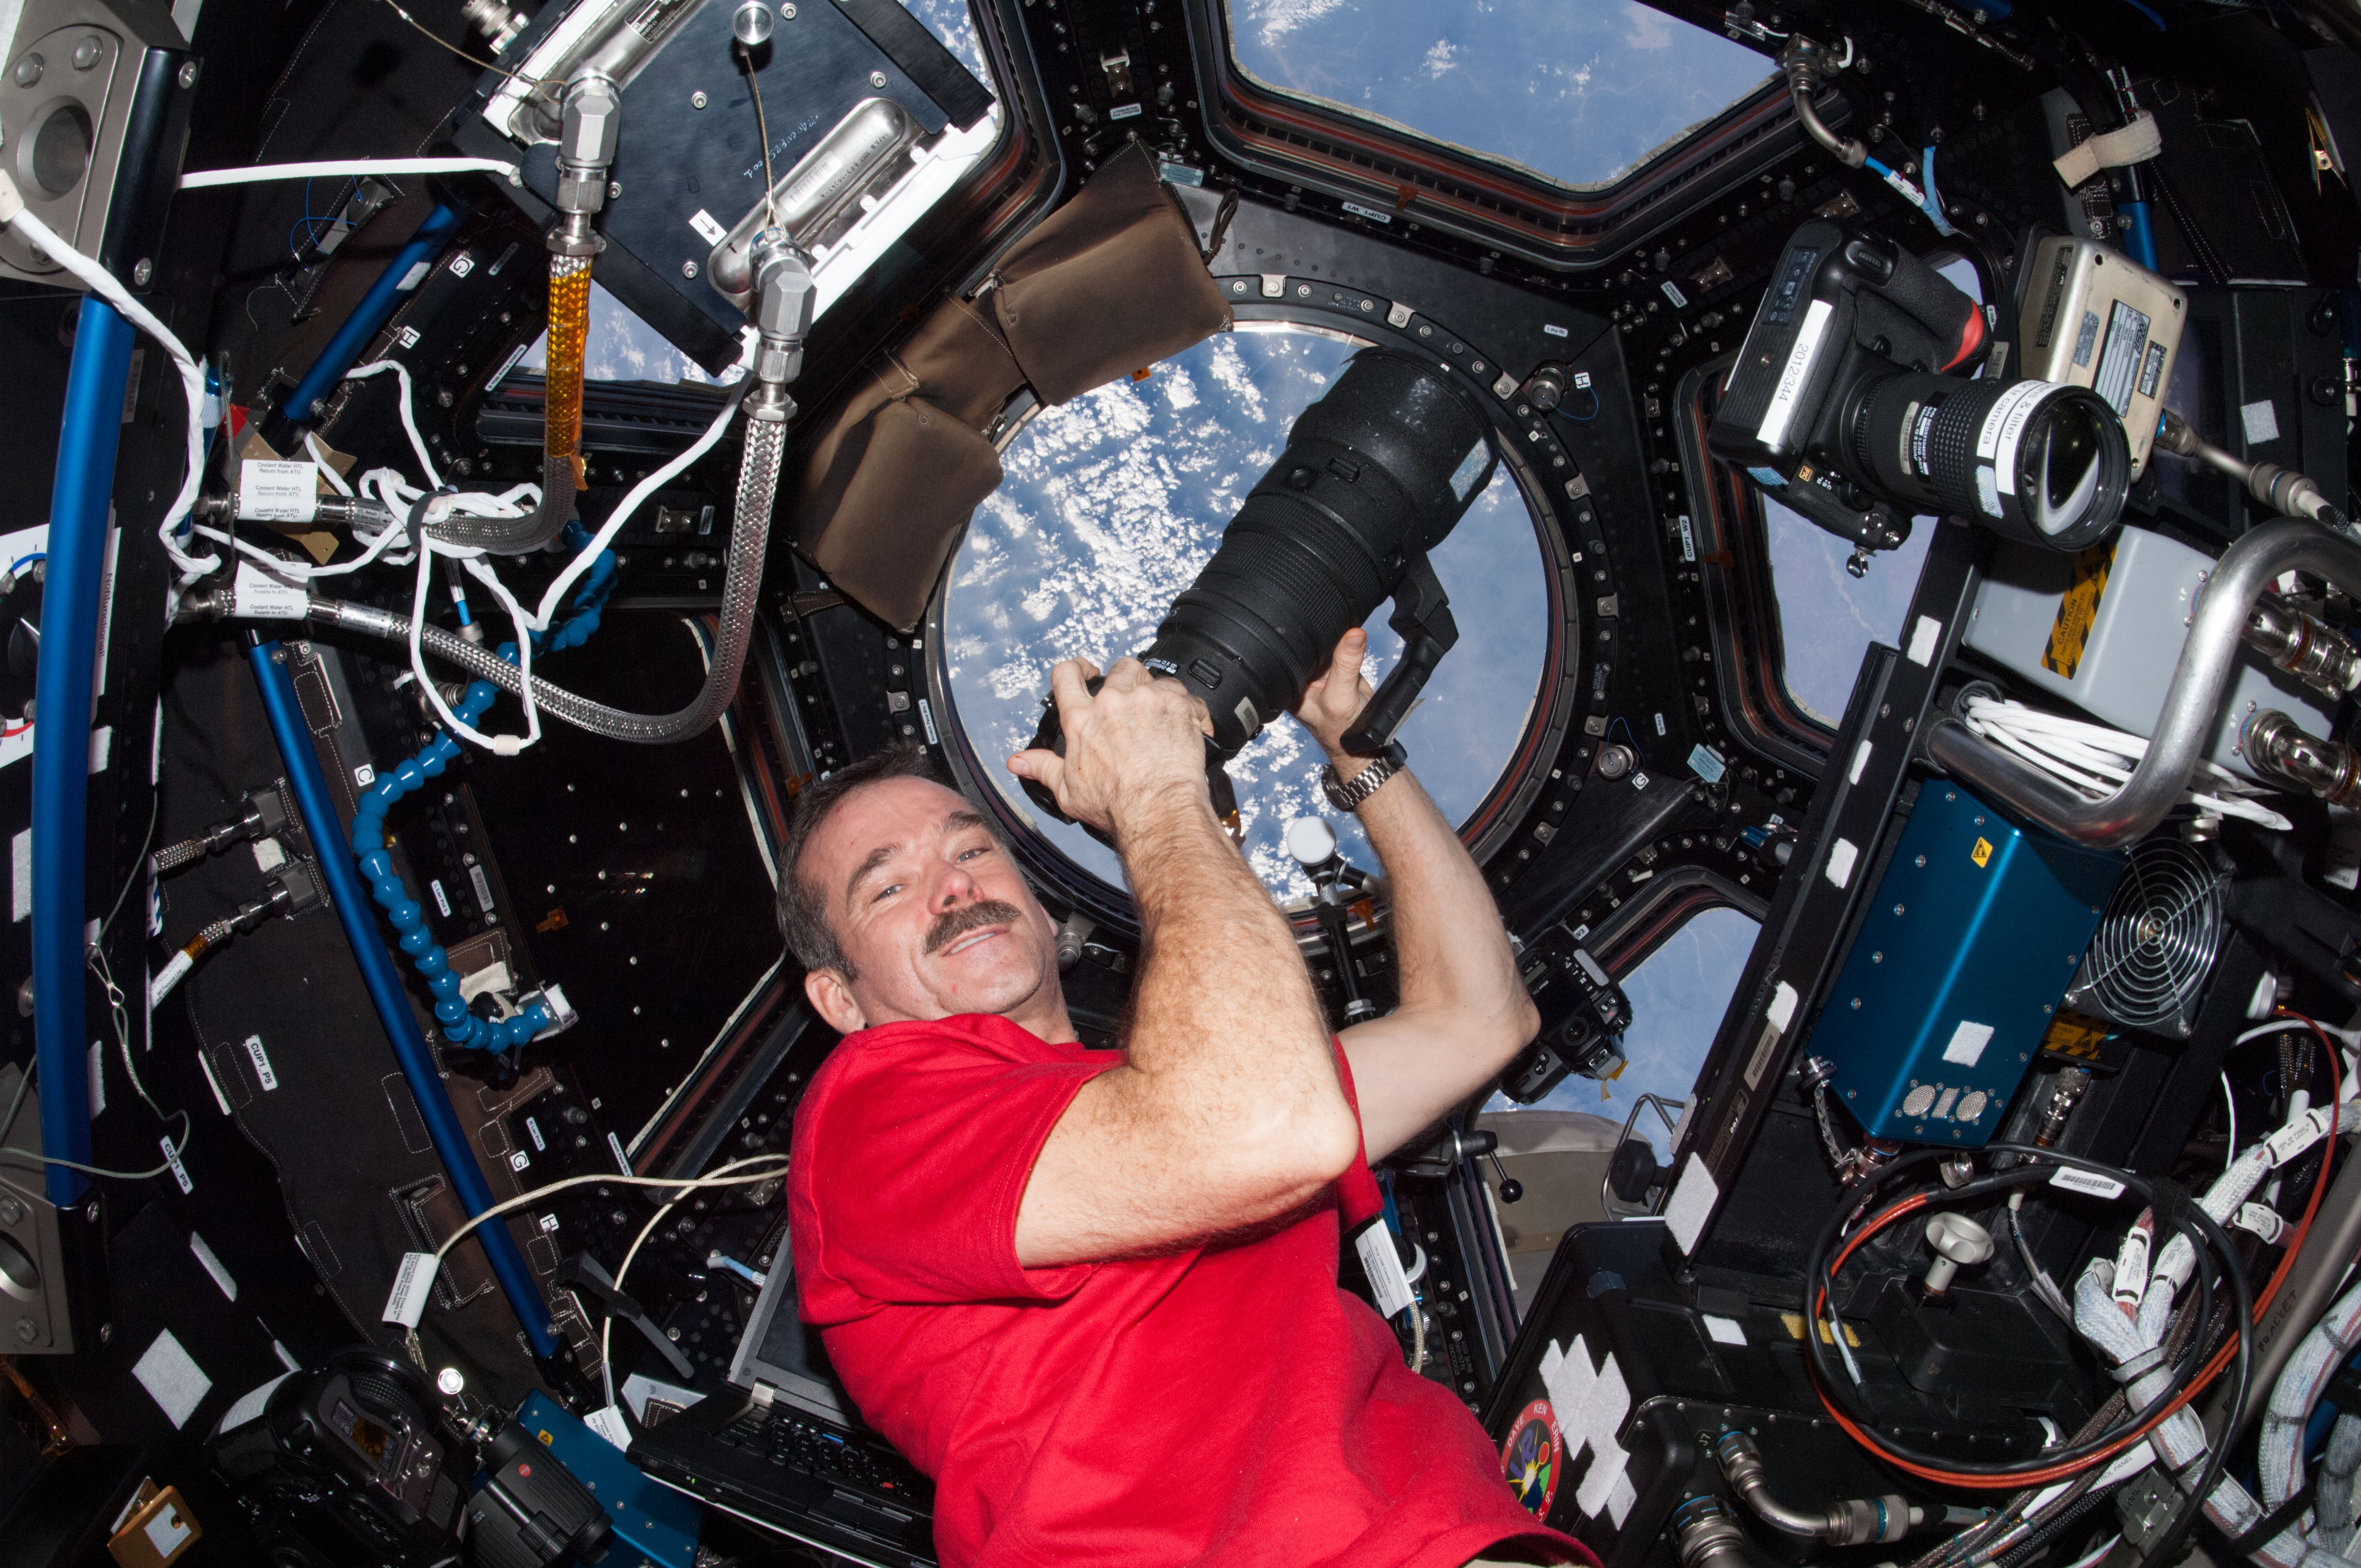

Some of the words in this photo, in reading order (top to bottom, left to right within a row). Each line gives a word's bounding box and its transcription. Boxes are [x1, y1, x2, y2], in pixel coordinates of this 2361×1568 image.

[1346, 204, 1386, 221] CUP1_W1
[454, 258, 469, 274] G
[397, 329, 417, 350] H
[507, 346, 524, 365] Scratch
[498, 363, 509, 377] Pane
[1777, 342, 1809, 402] 2012/344
[491, 374, 501, 385] Win
[1577, 375, 1589, 386] H
[1924, 405, 1932, 417] S/N
[2020, 401, 2031, 410] &
[1982, 396, 2010, 446] camera
[2004, 411, 2023, 443] filter
[1681, 519, 1692, 557] CUP1_W2
[97, 573, 113, 657] Nonfunctional!
[2056, 598, 2078, 645] CAUTION
[927, 725, 935, 742] Scratch
[357, 768, 372, 782] C
[1635, 775, 1646, 786] G
[435, 888, 443, 900] Lwr
[250, 1042, 273, 1085] CUP1_P5
[609, 1135, 621, 1153] Scratch
[617, 1152, 625, 1164] Pane
[163, 1143, 189, 1187] CU1_P5
[513, 1155, 526, 1168] G
[542, 1216, 558, 1231] H
[411, 1254, 421, 1273] Enhanced
[1382, 1267, 1392, 1284] Camera
[390, 1291, 399, 1305] Supply
[394, 1296, 402, 1310] Supply
[1533, 1403, 1547, 1415] KEN
[1506, 1415, 1526, 1447] DAVE
[1551, 1420, 1560, 1452] ERIN
[1698, 1432, 1711, 1446] J7
[2112, 1454, 2133, 1472] PANEL
